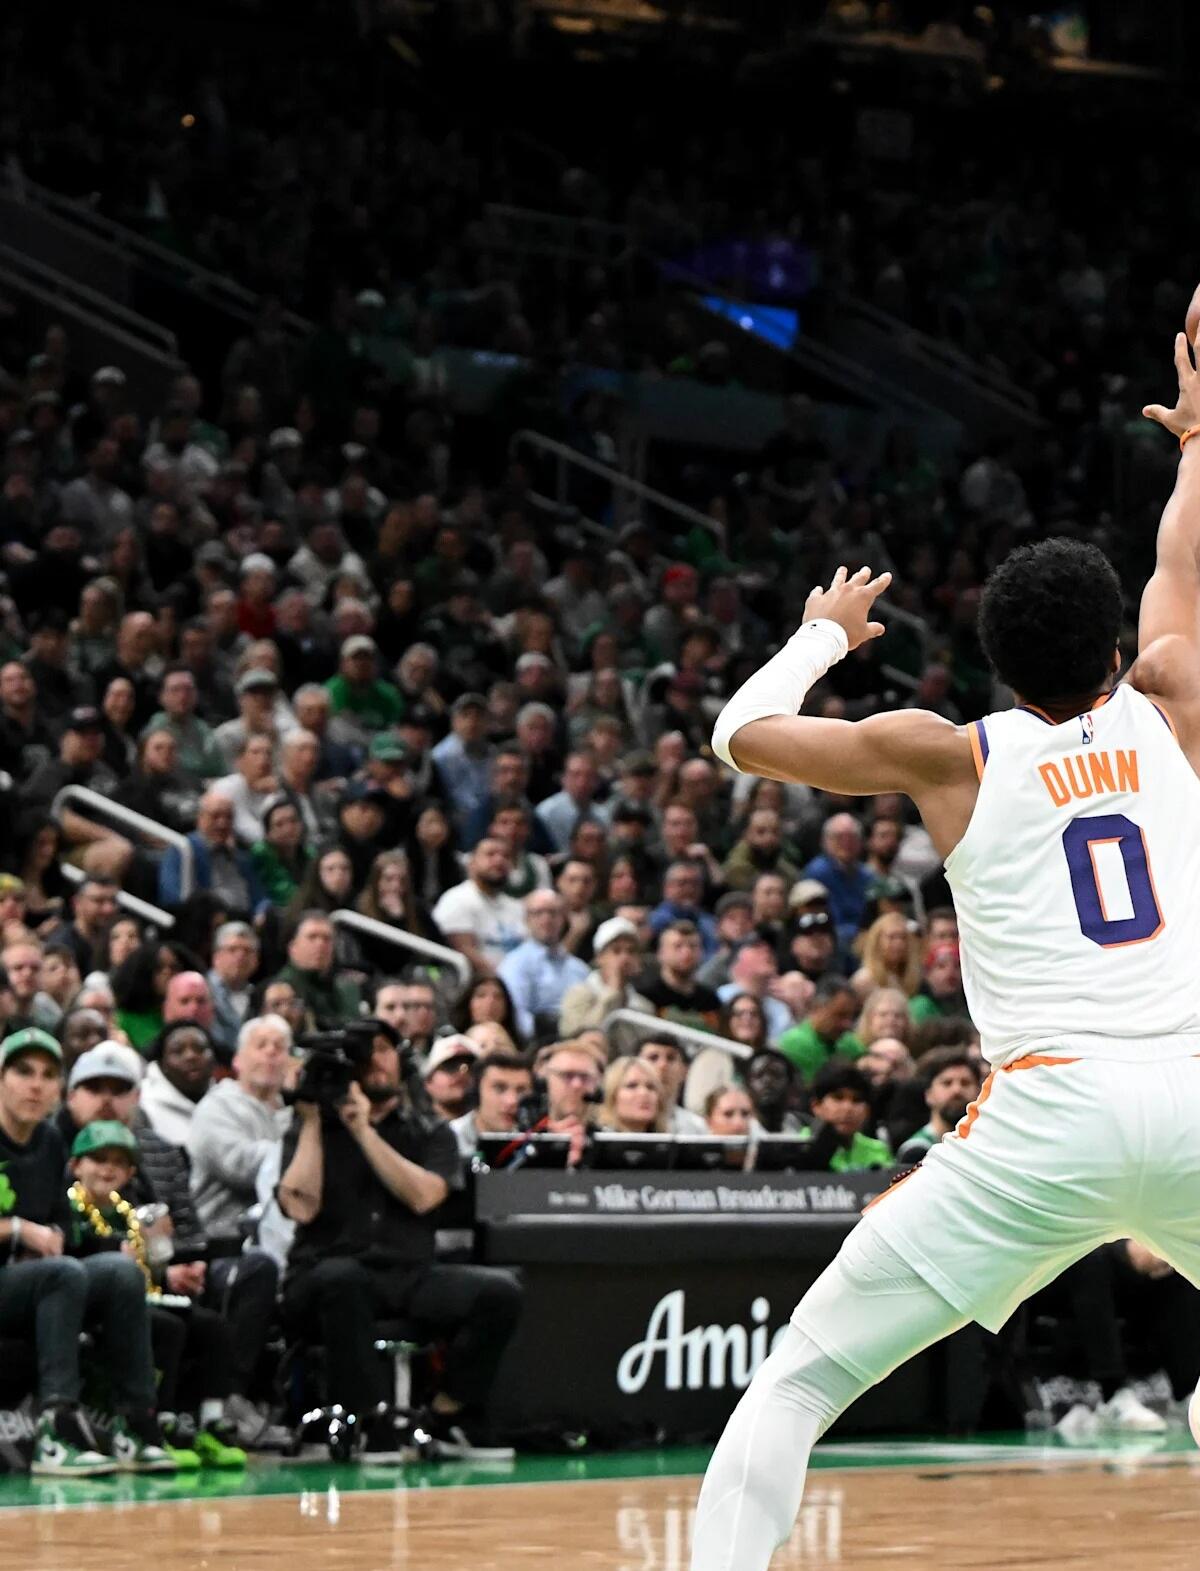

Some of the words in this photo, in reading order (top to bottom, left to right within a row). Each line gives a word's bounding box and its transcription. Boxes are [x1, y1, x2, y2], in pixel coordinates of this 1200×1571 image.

[1038, 750, 1140, 807] DUNN
[1062, 813, 1166, 949] 0
[594, 1184, 639, 1211] Mike
[641, 1185, 716, 1211] Gorman
[717, 1184, 807, 1210] Broadcast
[807, 1184, 856, 1210] Table
